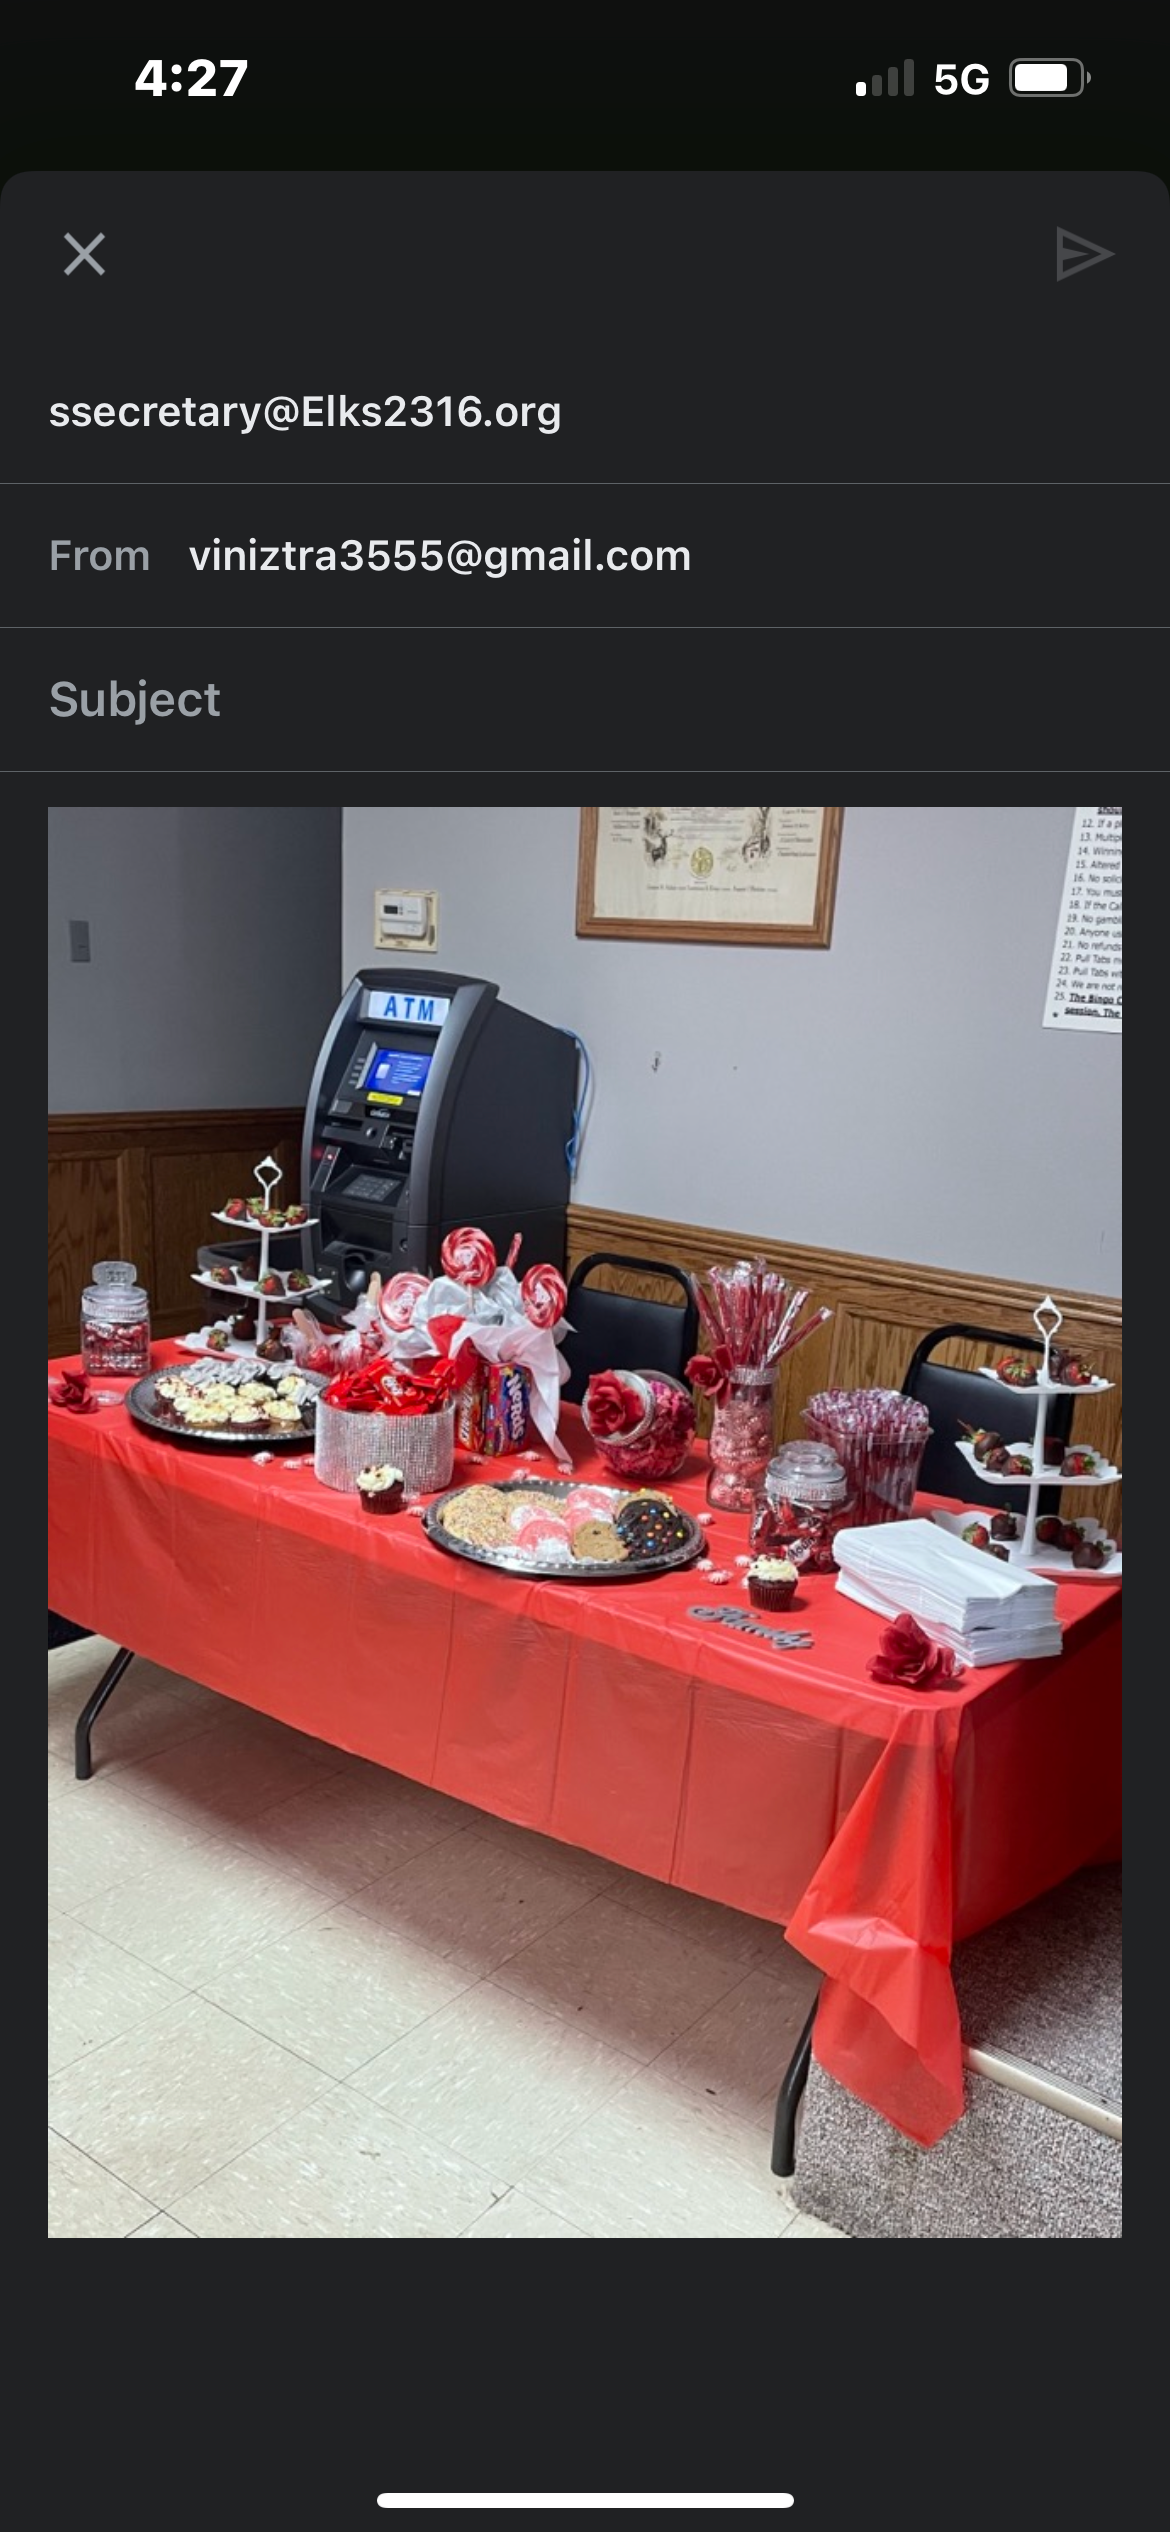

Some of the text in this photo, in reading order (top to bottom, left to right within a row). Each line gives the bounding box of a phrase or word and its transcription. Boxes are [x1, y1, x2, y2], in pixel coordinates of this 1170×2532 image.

[135, 59, 247, 96] 4:27
[935, 63, 989, 95] 5G
[50, 395, 560, 434] ssecretary@Elks2316.org
[52, 538, 690, 578] From viniztra3555@gmail.com
[51, 679, 220, 725] Subject
[1082, 819, 1095, 828] 12.
[1080, 832, 1092, 841] 13.
[1078, 847, 1091, 856] 14.
[1076, 860, 1088, 869] 15.
[1074, 873, 1086, 882] 16.
[1088, 874, 1100, 883] No
[1086, 888, 1100, 897] You
[1069, 900, 1081, 909] 18.
[1093, 901, 1107, 910] the
[1067, 913, 1080, 922] 19.
[1081, 914, 1093, 923] No
[1064, 927, 1077, 936] 20.
[1079, 927, 1109, 938] Anyone
[1062, 940, 1075, 949] 21.
[1077, 941, 1089, 950] No
[1060, 952, 1073, 962] 22.
[1075, 954, 1090, 963] Pull
[1092, 954, 1111, 964] Tabs
[1058, 966, 1071, 975] 23.
[1072, 966, 1088, 976] Pull
[1091, 967, 1109, 977] Tabs
[1056, 978, 1069, 988] 24.
[1071, 980, 1084, 989] We
[1086, 982, 1099, 990] are
[1101, 982, 1116, 991] not
[1054, 991, 1067, 1001] 25.
[1069, 992, 1086, 1003] The
[1088, 993, 1114, 1005] Bingo
[384, 995, 434, 1021] ATM
[1102, 1008, 1121, 1019] The
[507, 1373, 526, 1441] Nerds
